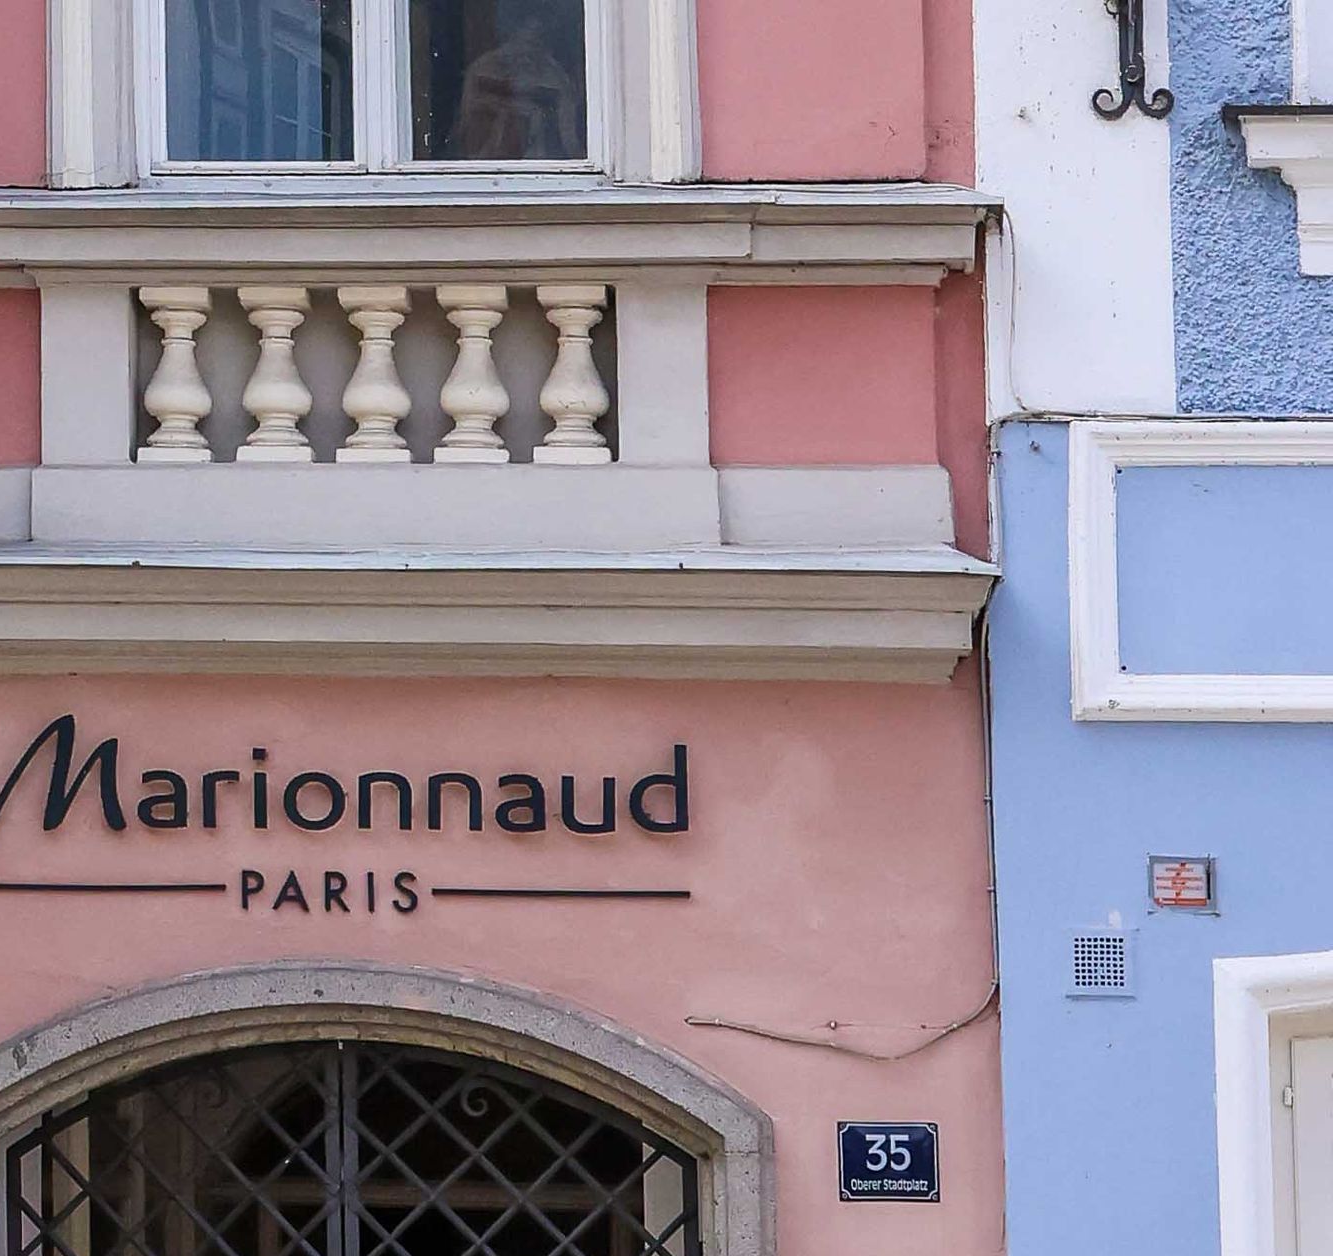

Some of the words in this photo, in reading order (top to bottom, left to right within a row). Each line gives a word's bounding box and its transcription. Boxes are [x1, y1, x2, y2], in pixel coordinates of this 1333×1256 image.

[240, 869, 419, 914] PARIS
[865, 1134, 912, 1171] 35
[851, 1179, 882, 1191] Oberer
[883, 1179, 928, 1192] Stadtplatz
